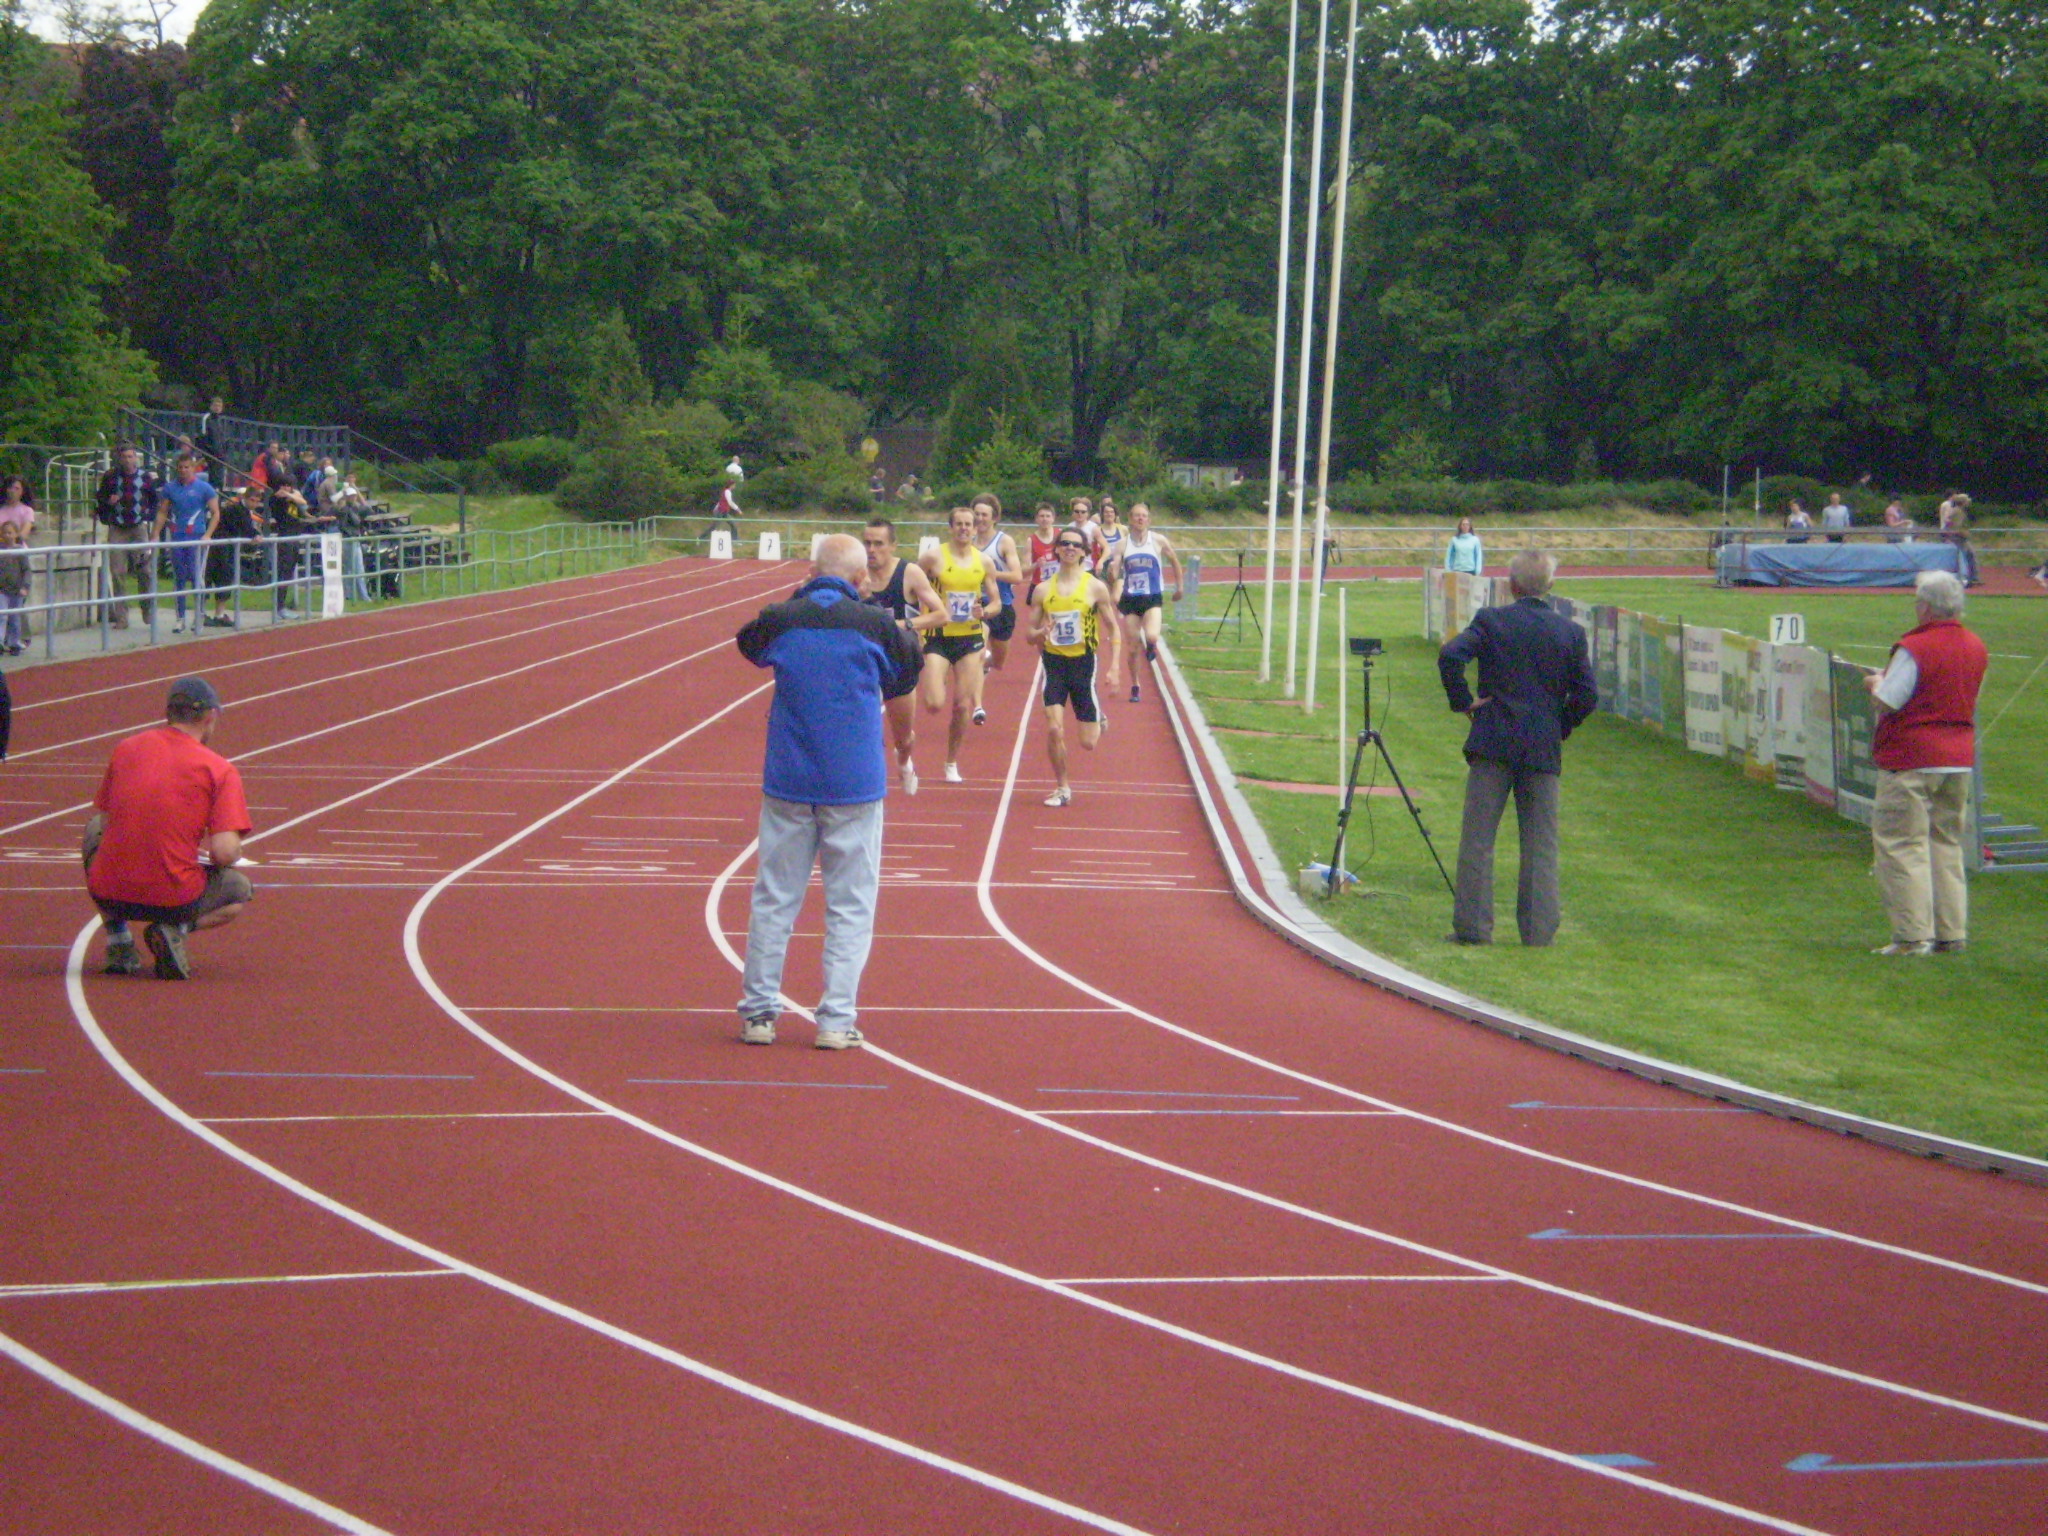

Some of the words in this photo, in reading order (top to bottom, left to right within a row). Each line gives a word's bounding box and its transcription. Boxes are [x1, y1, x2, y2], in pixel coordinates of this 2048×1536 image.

[717, 538, 724, 552] 8
[767, 538, 773, 553] 7
[1132, 579, 1146, 590] 12
[951, 600, 970, 614] 14
[1055, 621, 1075, 635] 15
[1775, 616, 1798, 640] 70
